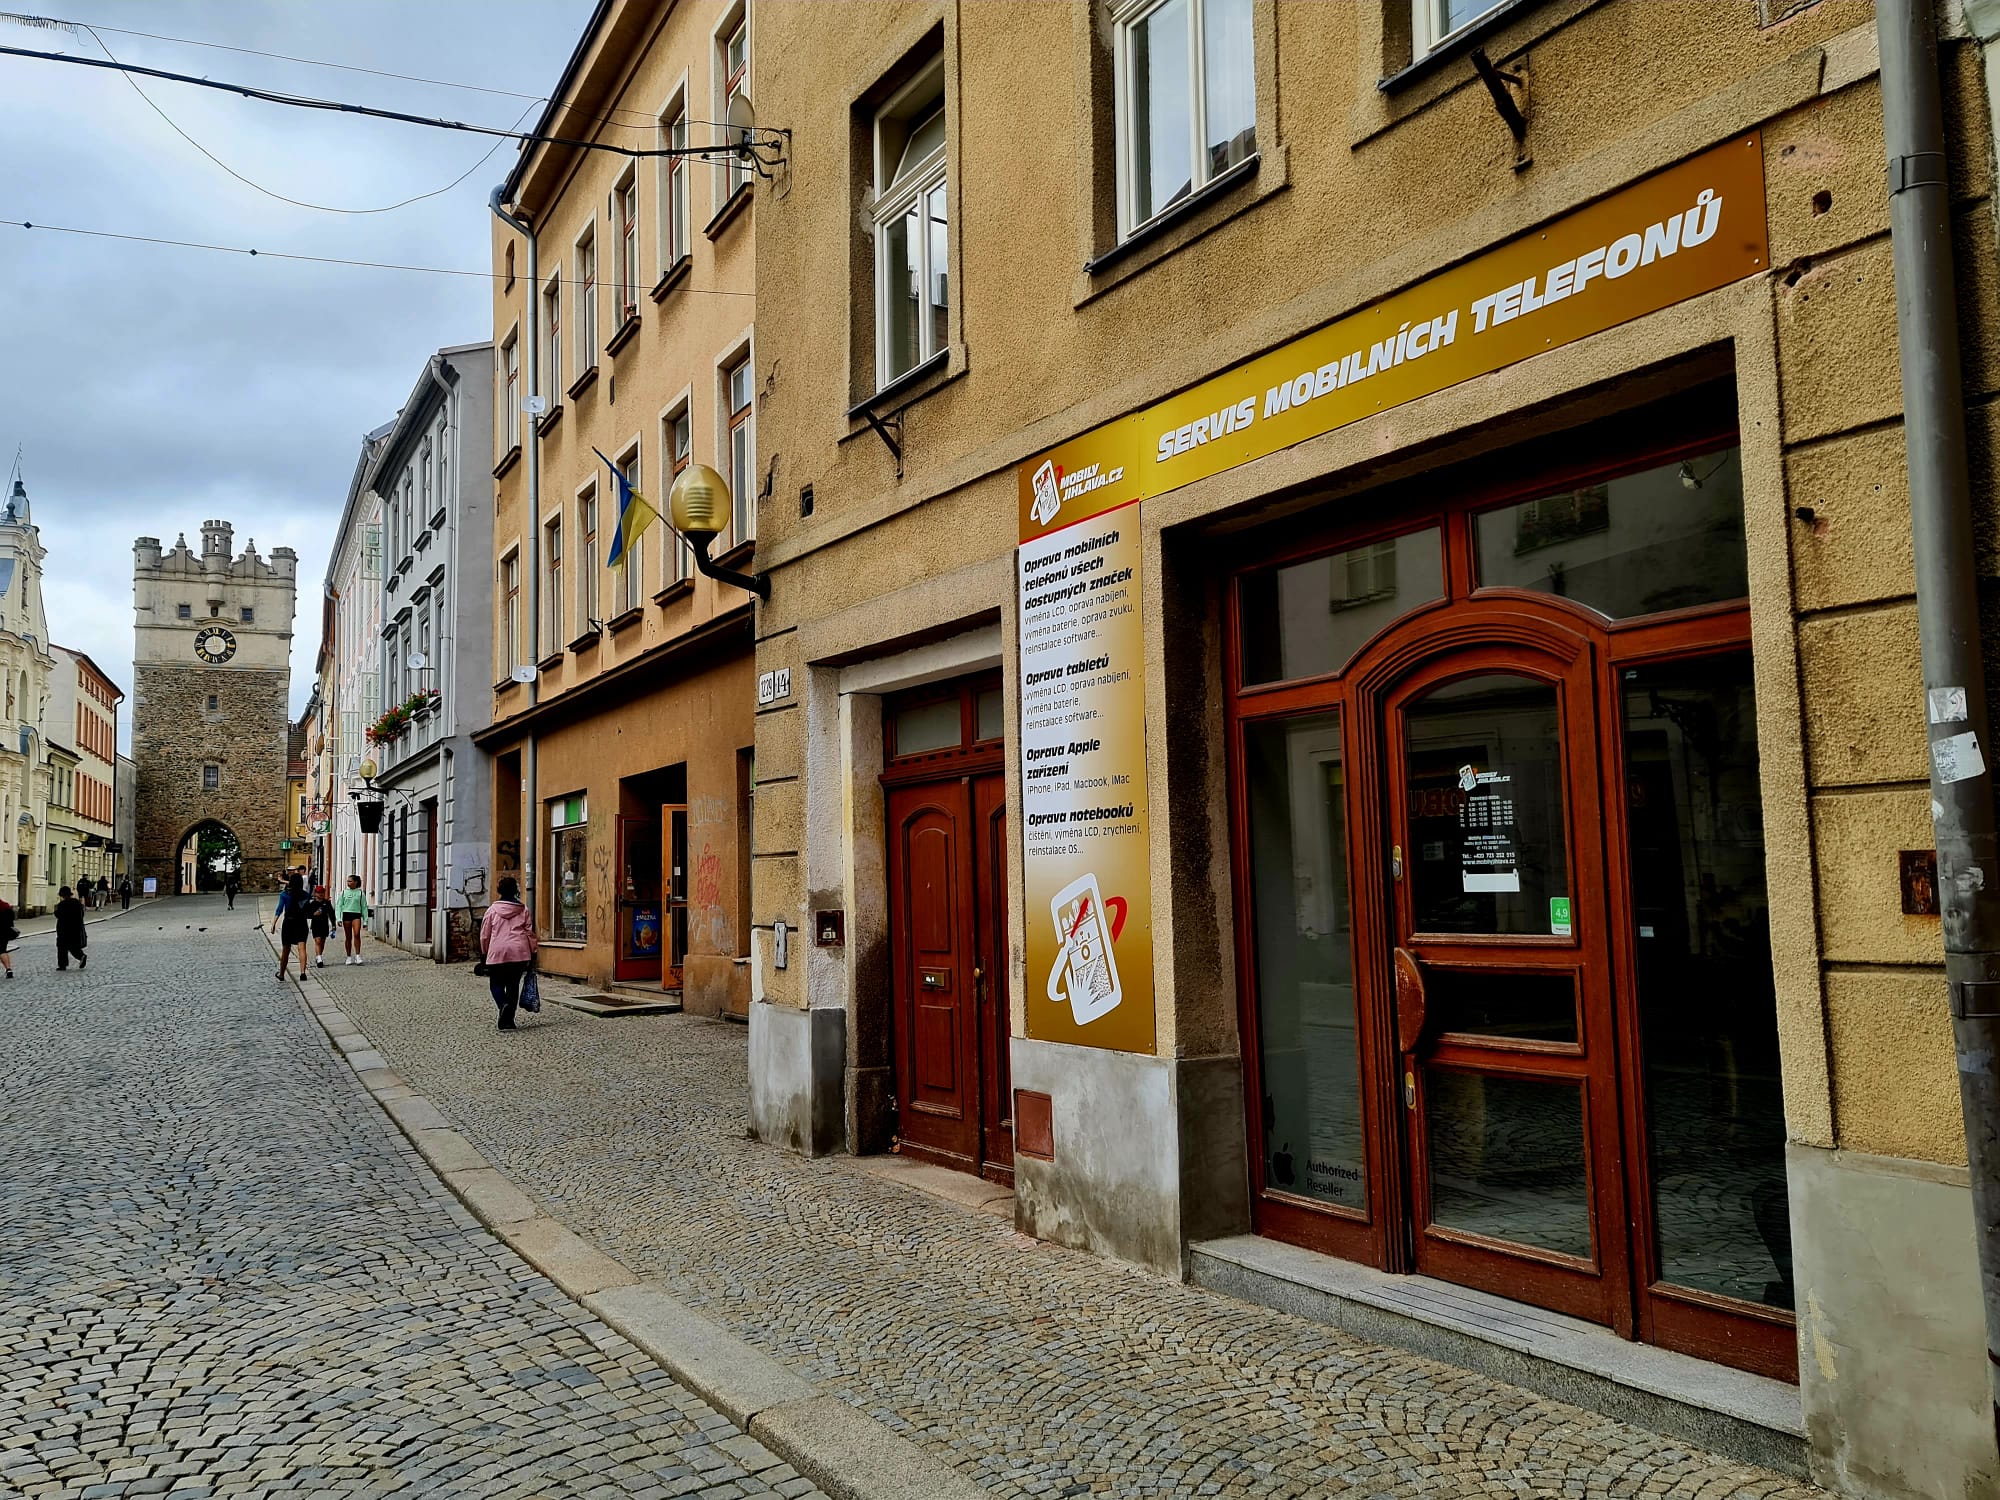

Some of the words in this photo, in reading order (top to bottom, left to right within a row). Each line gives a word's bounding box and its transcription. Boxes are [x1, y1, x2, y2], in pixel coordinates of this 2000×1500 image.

[1156, 396, 1257, 463] SERVIS
[1263, 311, 1459, 417] MOBILNÍCH
[1472, 188, 1724, 334] TELEFONŮ
[1060, 463, 1100, 489] MOBILY
[1063, 466, 1124, 501] JIHLAVA.CZ
[1024, 551, 1061, 573] Oprava
[1064, 530, 1119, 559] mobilních
[1025, 565, 1068, 592] telefonů
[1071, 556, 1104, 576] všech
[1025, 581, 1086, 610] dostupných
[1090, 567, 1133, 590] značek
[1025, 608, 1050, 625] výměna
[1052, 605, 1067, 617] LCD,
[1069, 598, 1093, 612] oprava
[1096, 587, 1129, 604] nabíjení,
[1025, 626, 1050, 640] výměna
[1052, 619, 1080, 632] baterie,
[1081, 611, 1107, 625] oprava
[1109, 604, 1135, 617] zvuku,
[1025, 638, 1061, 655] reinstalace
[1064, 629, 1103, 645] software...
[1026, 667, 1063, 686] Oprava
[1066, 653, 1109, 676] tabletů
[777, 673, 786, 693] 14
[1026, 687, 1051, 701] výměna
[1070, 678, 1095, 692] oprava
[1097, 669, 1131, 685] nabíjení,
[1026, 701, 1051, 716] výměna
[1054, 697, 1080, 709] baterie,
[1026, 714, 1062, 730] reinstalace
[1065, 709, 1104, 724] software...
[1027, 745, 1065, 762] Oprava
[1067, 739, 1100, 756] Apple
[1027, 761, 1069, 779] zařízení
[1074, 776, 1110, 789] Macbook,
[1112, 774, 1130, 784] iMac
[1028, 812, 1067, 827] Oprava
[1070, 802, 1134, 822] notebooků
[1055, 828, 1082, 840] výměna
[1084, 826, 1101, 837] LCD,
[1103, 822, 1142, 836] zrychlení,
[1028, 846, 1066, 856] reinstalace
[1068, 844, 1083, 854] OS...
[1306, 1160, 1358, 1181] Authorized
[1307, 1178, 1344, 1197] Reseller
